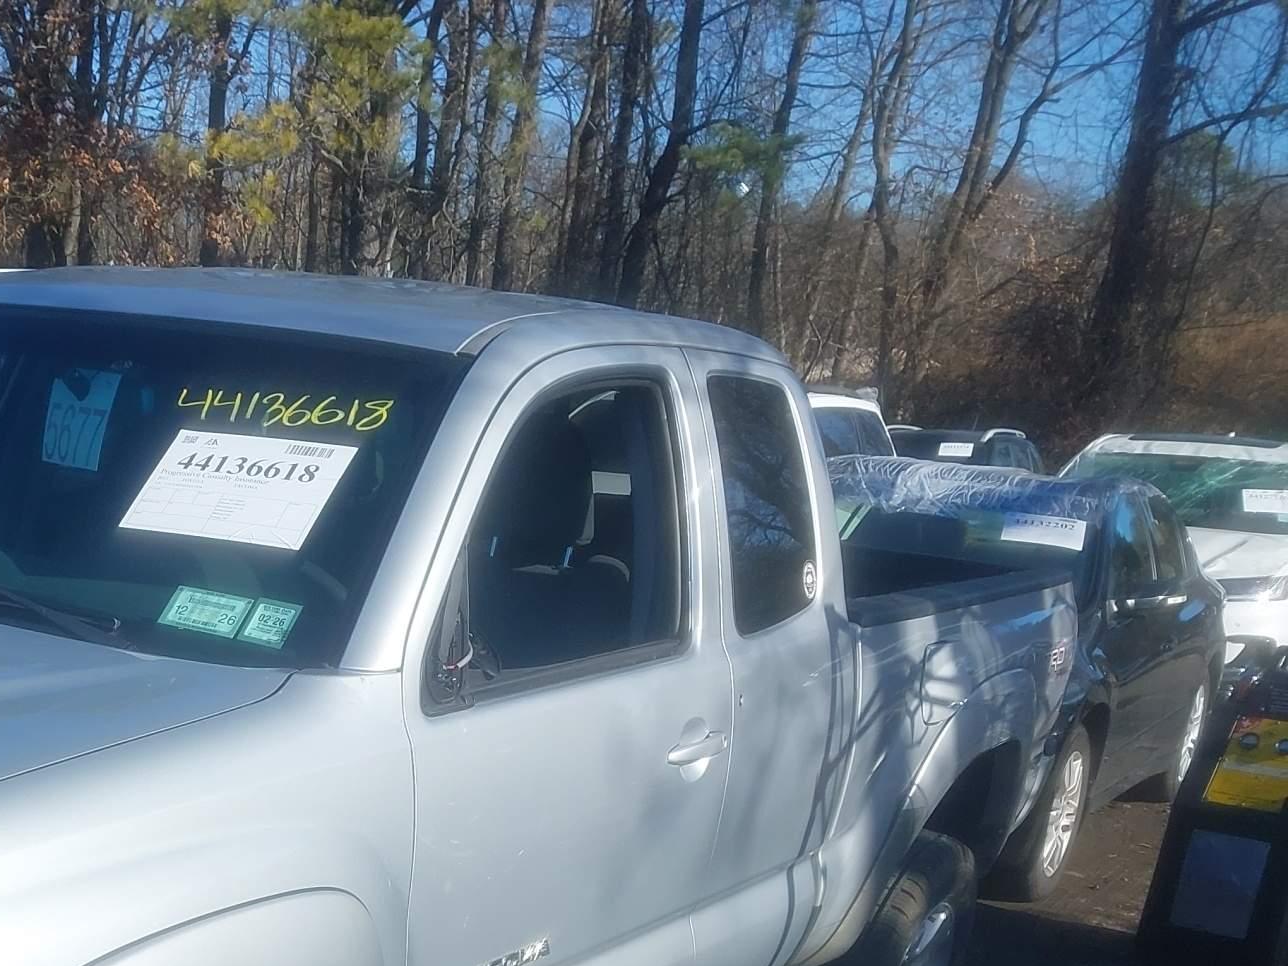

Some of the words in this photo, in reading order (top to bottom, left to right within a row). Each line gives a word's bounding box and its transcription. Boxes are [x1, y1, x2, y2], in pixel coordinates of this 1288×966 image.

[178, 388, 395, 432] 44136618
[177, 451, 322, 484] 44136618
[175, 604, 189, 616] 12
[217, 613, 237, 626] 26
